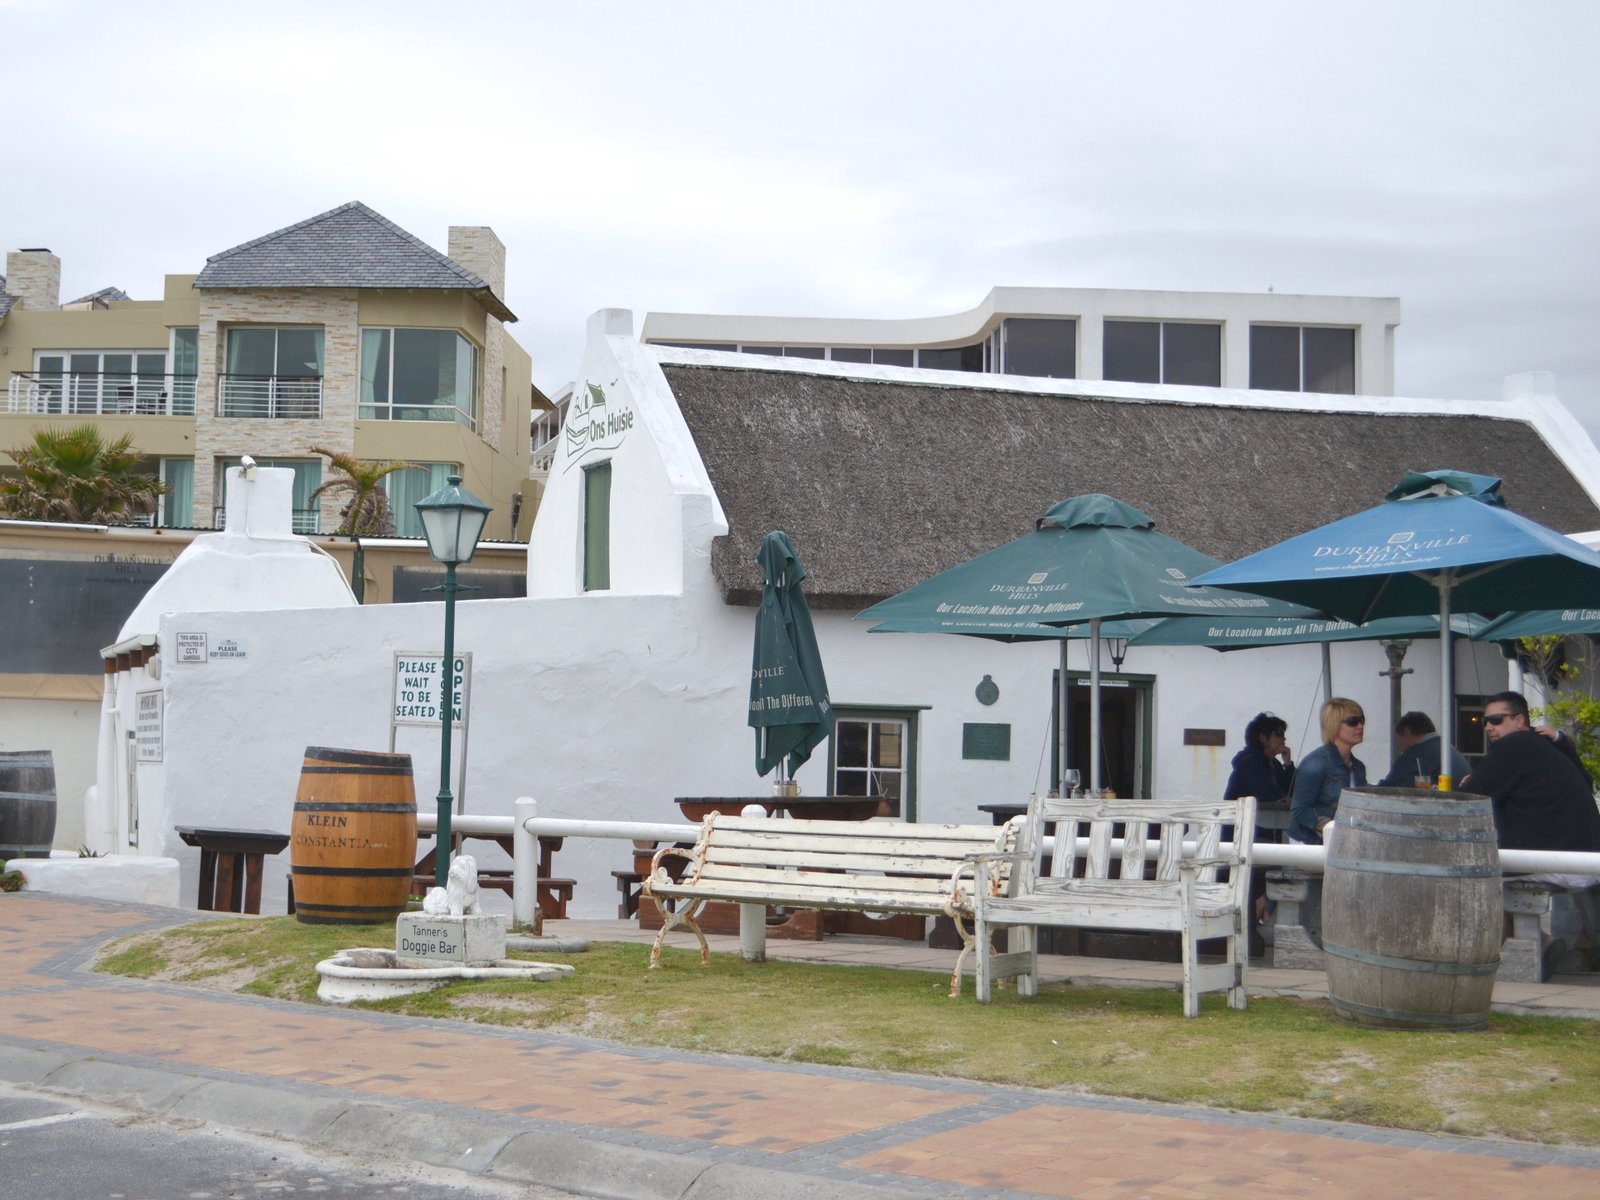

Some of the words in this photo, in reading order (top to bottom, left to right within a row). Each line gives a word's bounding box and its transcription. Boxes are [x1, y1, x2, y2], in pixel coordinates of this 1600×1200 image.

[590, 419, 605, 442] Ons
[608, 406, 634, 436] Huisie
[1312, 534, 1472, 557] DURBANVILLE
[1354, 551, 1415, 563] HILLS
[990, 583, 1070, 592] DURBANVILLE
[1008, 592, 1040, 600] HILLS
[936, 602, 954, 613] Our
[952, 603, 989, 615] Location
[988, 605, 1016, 615] Makes
[1014, 604, 1031, 615] All
[1029, 604, 1045, 614] The
[1043, 602, 1084, 613] Difference
[1561, 609, 1578, 621] Our
[1208, 627, 1224, 637] Our
[1225, 627, 1262, 637] Location
[1264, 626, 1292, 636] Makes
[1293, 624, 1306, 634] All
[1308, 623, 1323, 633] The
[398, 661, 437, 673] PLEASE
[404, 677, 429, 688] WAIT
[453, 659, 464, 721] OPEN
[401, 691, 414, 702] TO
[418, 691, 431, 702] BE
[766, 696, 780, 709] The
[396, 705, 435, 717] SEATED
[308, 815, 348, 828] KLEIN
[296, 836, 372, 848] CONSTANTIA
[413, 925, 448, 937] Tanner's
[402, 939, 436, 955] Doggie
[439, 941, 457, 954] Bar
